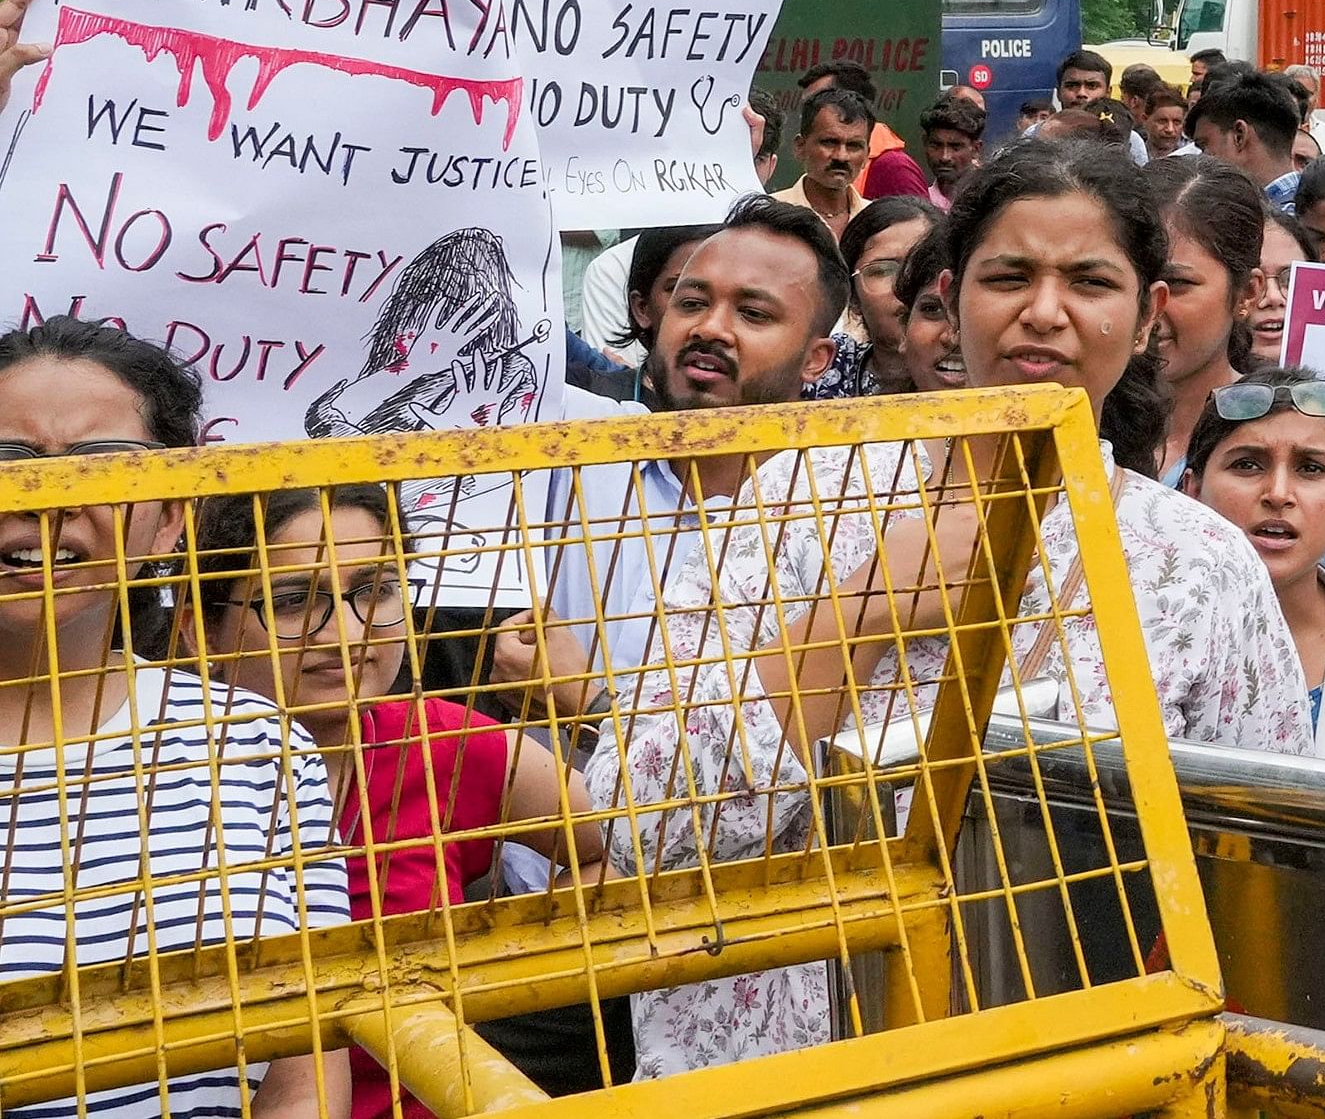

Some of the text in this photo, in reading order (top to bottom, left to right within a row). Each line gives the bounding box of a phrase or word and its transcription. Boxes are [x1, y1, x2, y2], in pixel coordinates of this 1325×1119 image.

[602, 3, 768, 64] SAFETY
[757, 37, 821, 72] ELHI
[981, 39, 1032, 58] POLICE
[974, 70, 988, 82] SD
[573, 82, 676, 137] DUTY
[88, 93, 168, 150] WE
[232, 121, 371, 187] WANT
[654, 159, 738, 198] RGKAR
[34, 172, 404, 303] NO SAFETY
